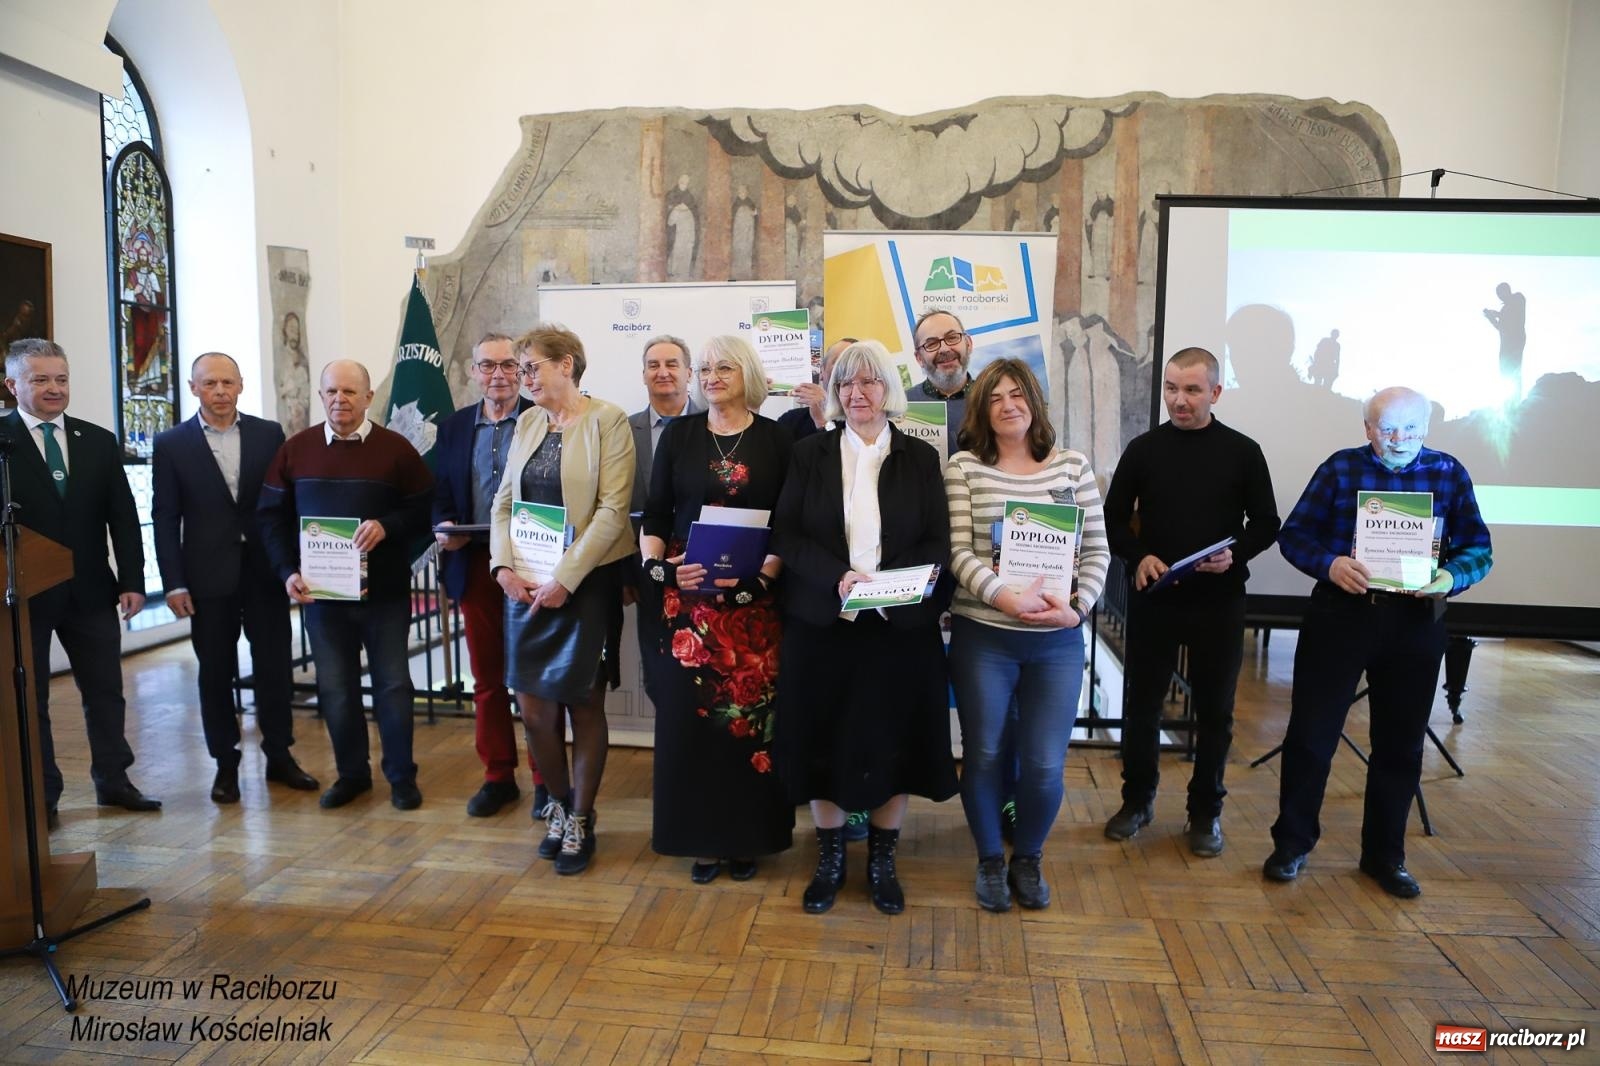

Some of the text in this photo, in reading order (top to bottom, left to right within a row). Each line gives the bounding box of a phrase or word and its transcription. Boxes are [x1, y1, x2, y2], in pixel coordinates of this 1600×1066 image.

[922, 293, 1009, 304] powiat raciborski
[612, 322, 652, 332] Racibórz
[759, 333, 803, 344] DYPLOM
[1365, 519, 1423, 530] DYPLOM
[516, 529, 558, 543] DYPLOM
[1010, 530, 1067, 544] DYPLOM
[307, 541, 353, 550] DYPLOM
